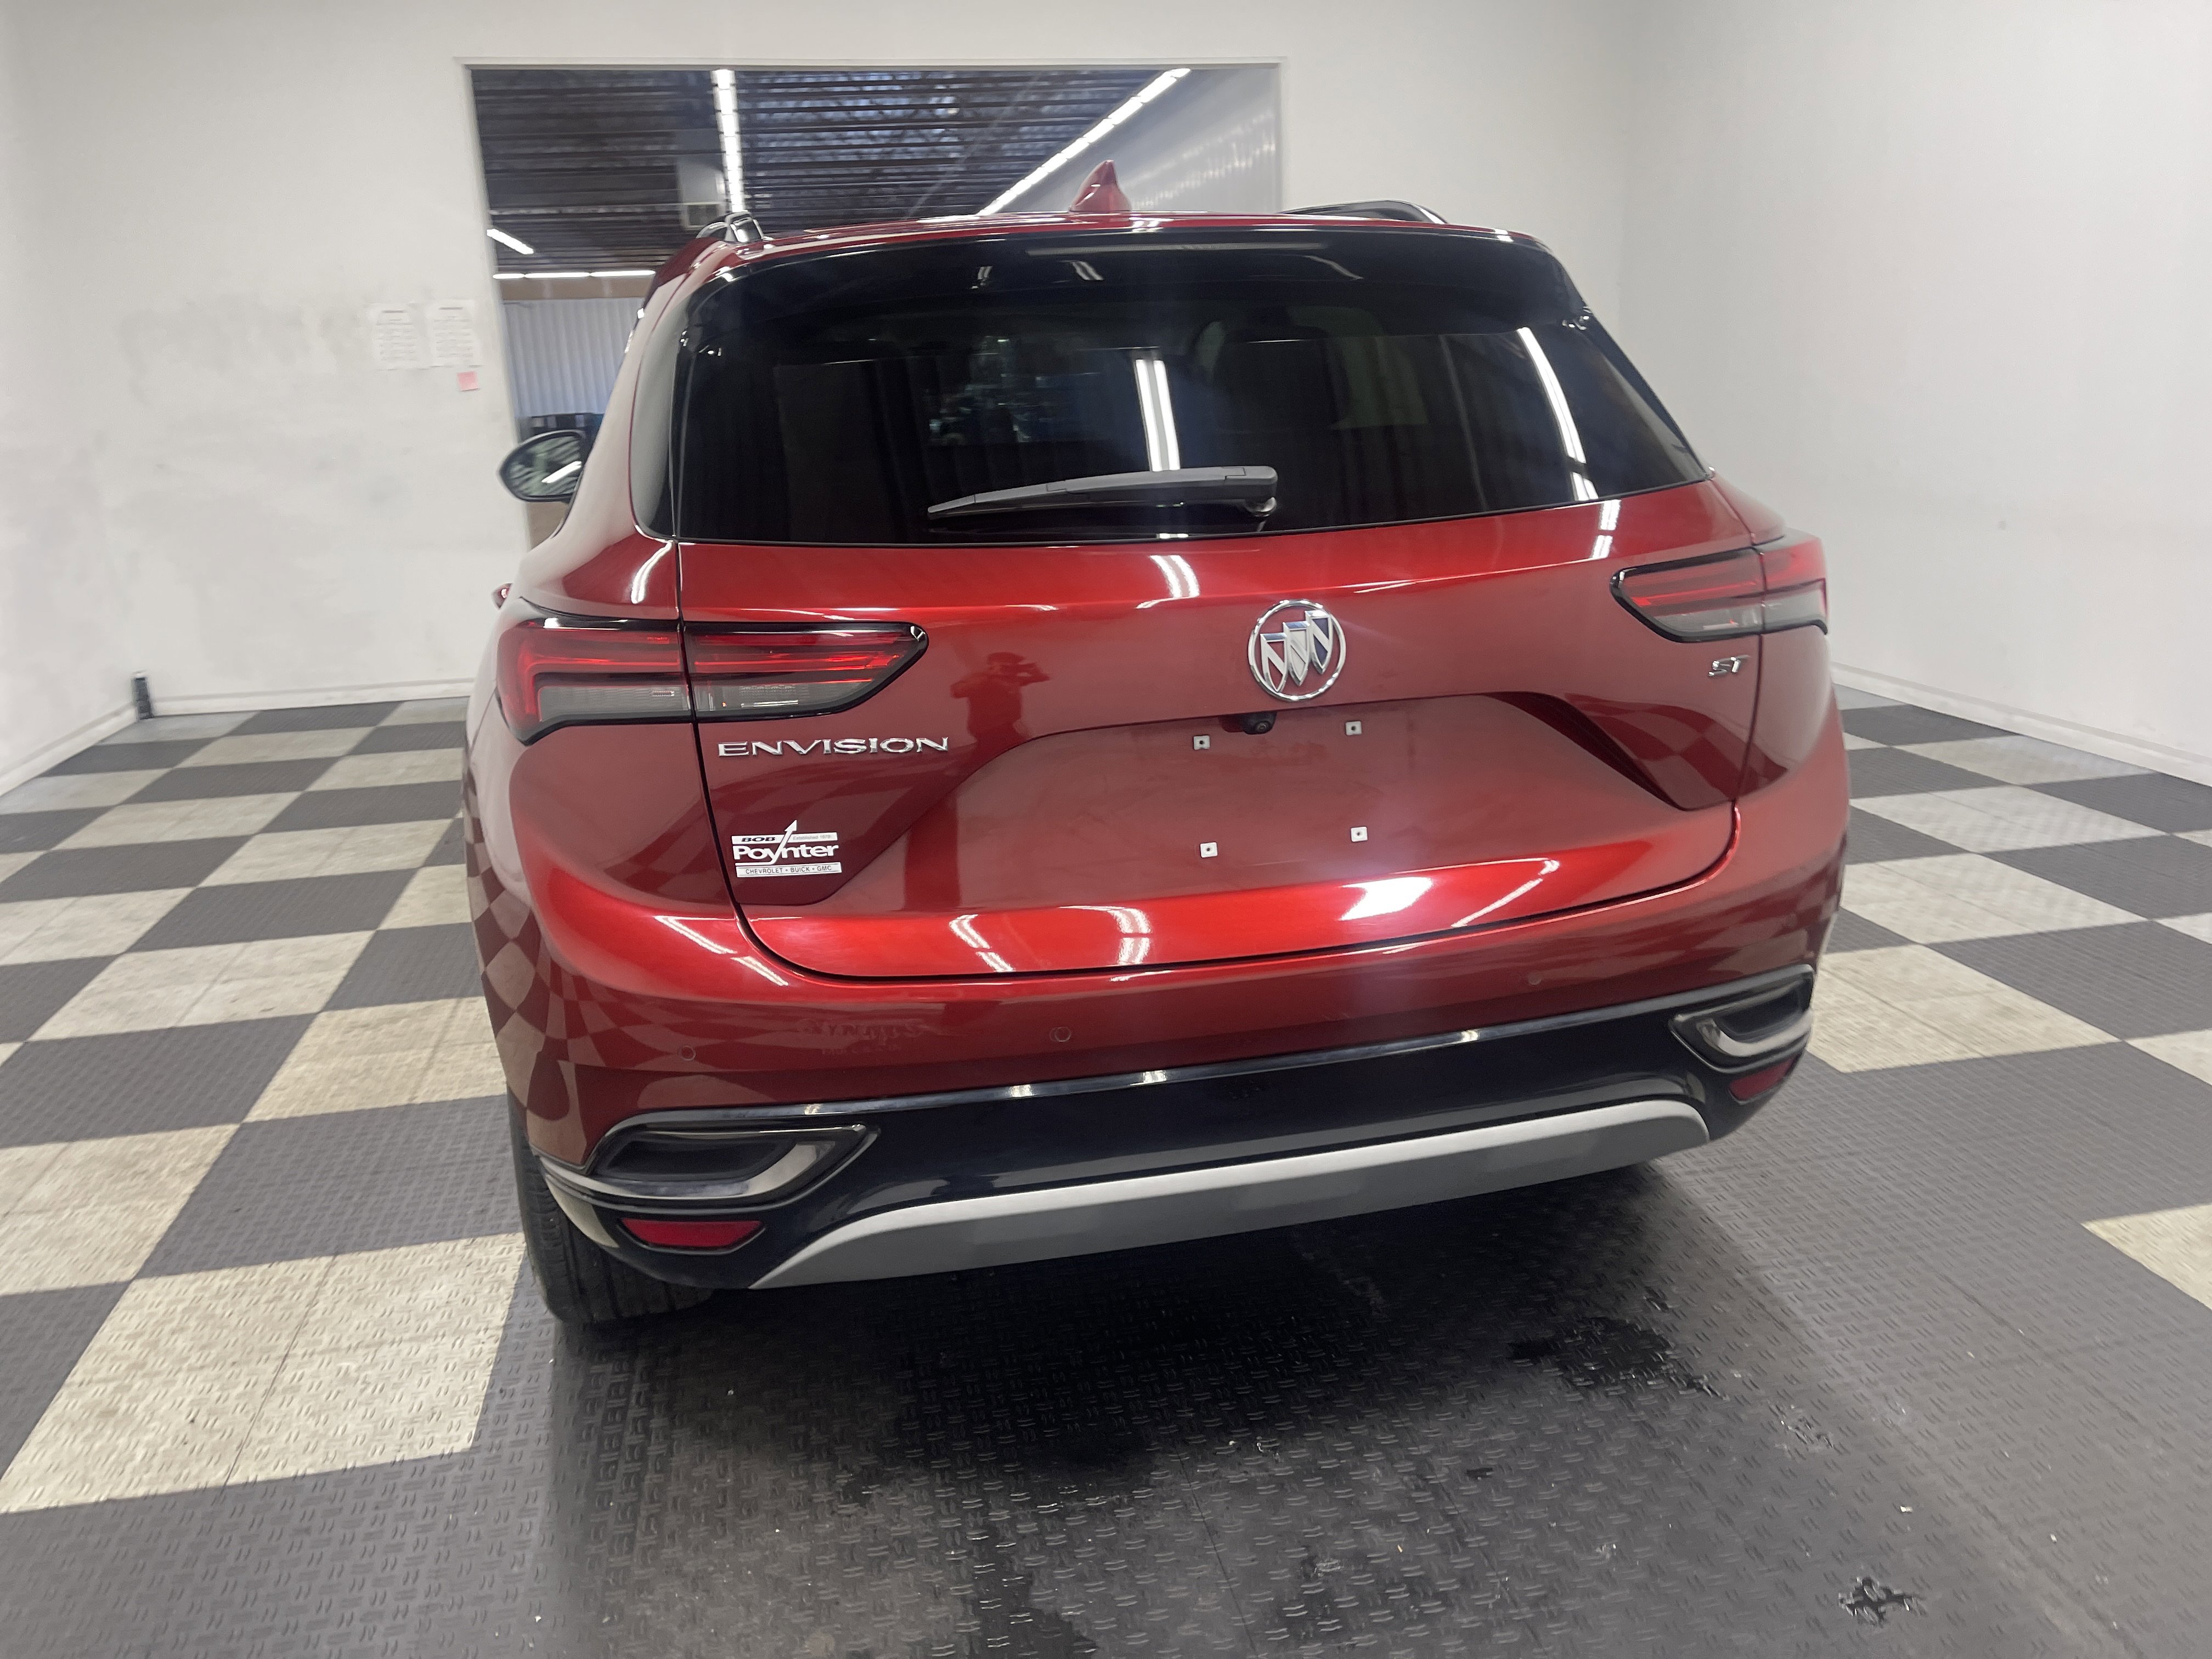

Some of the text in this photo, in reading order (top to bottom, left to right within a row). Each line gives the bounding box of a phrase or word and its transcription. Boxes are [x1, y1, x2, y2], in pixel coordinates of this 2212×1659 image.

[1708, 654, 1750, 676] ST
[718, 737, 949, 757] ENVISION
[732, 843, 839, 866] Poynter
